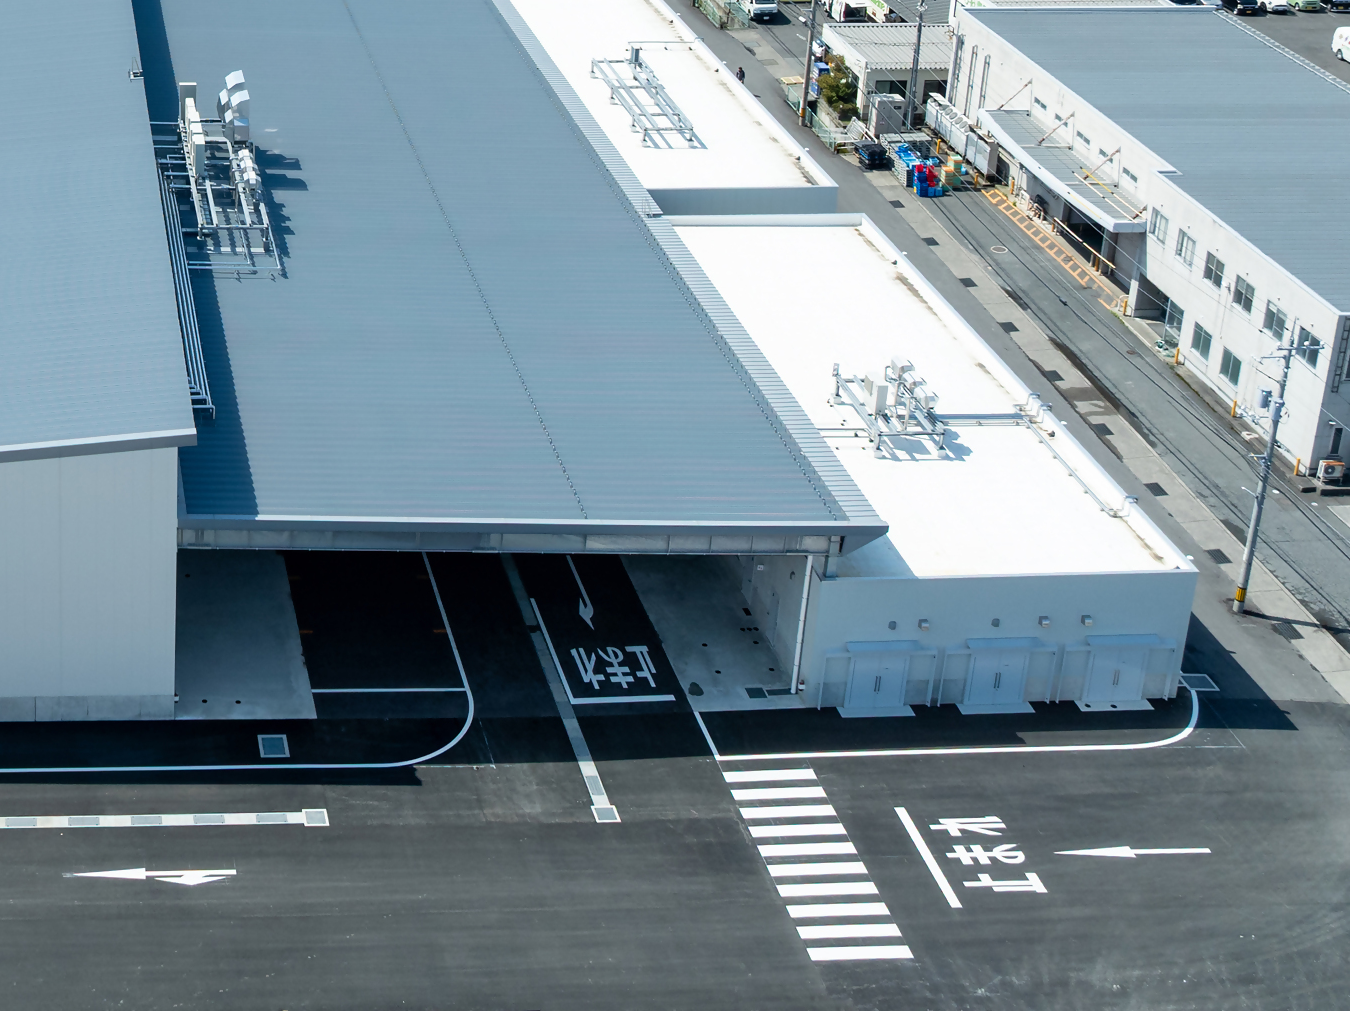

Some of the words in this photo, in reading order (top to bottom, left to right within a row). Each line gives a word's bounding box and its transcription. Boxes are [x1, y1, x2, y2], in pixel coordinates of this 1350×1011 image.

[570, 646, 657, 690] 止まれ
[928, 815, 1049, 894] 止まれ
